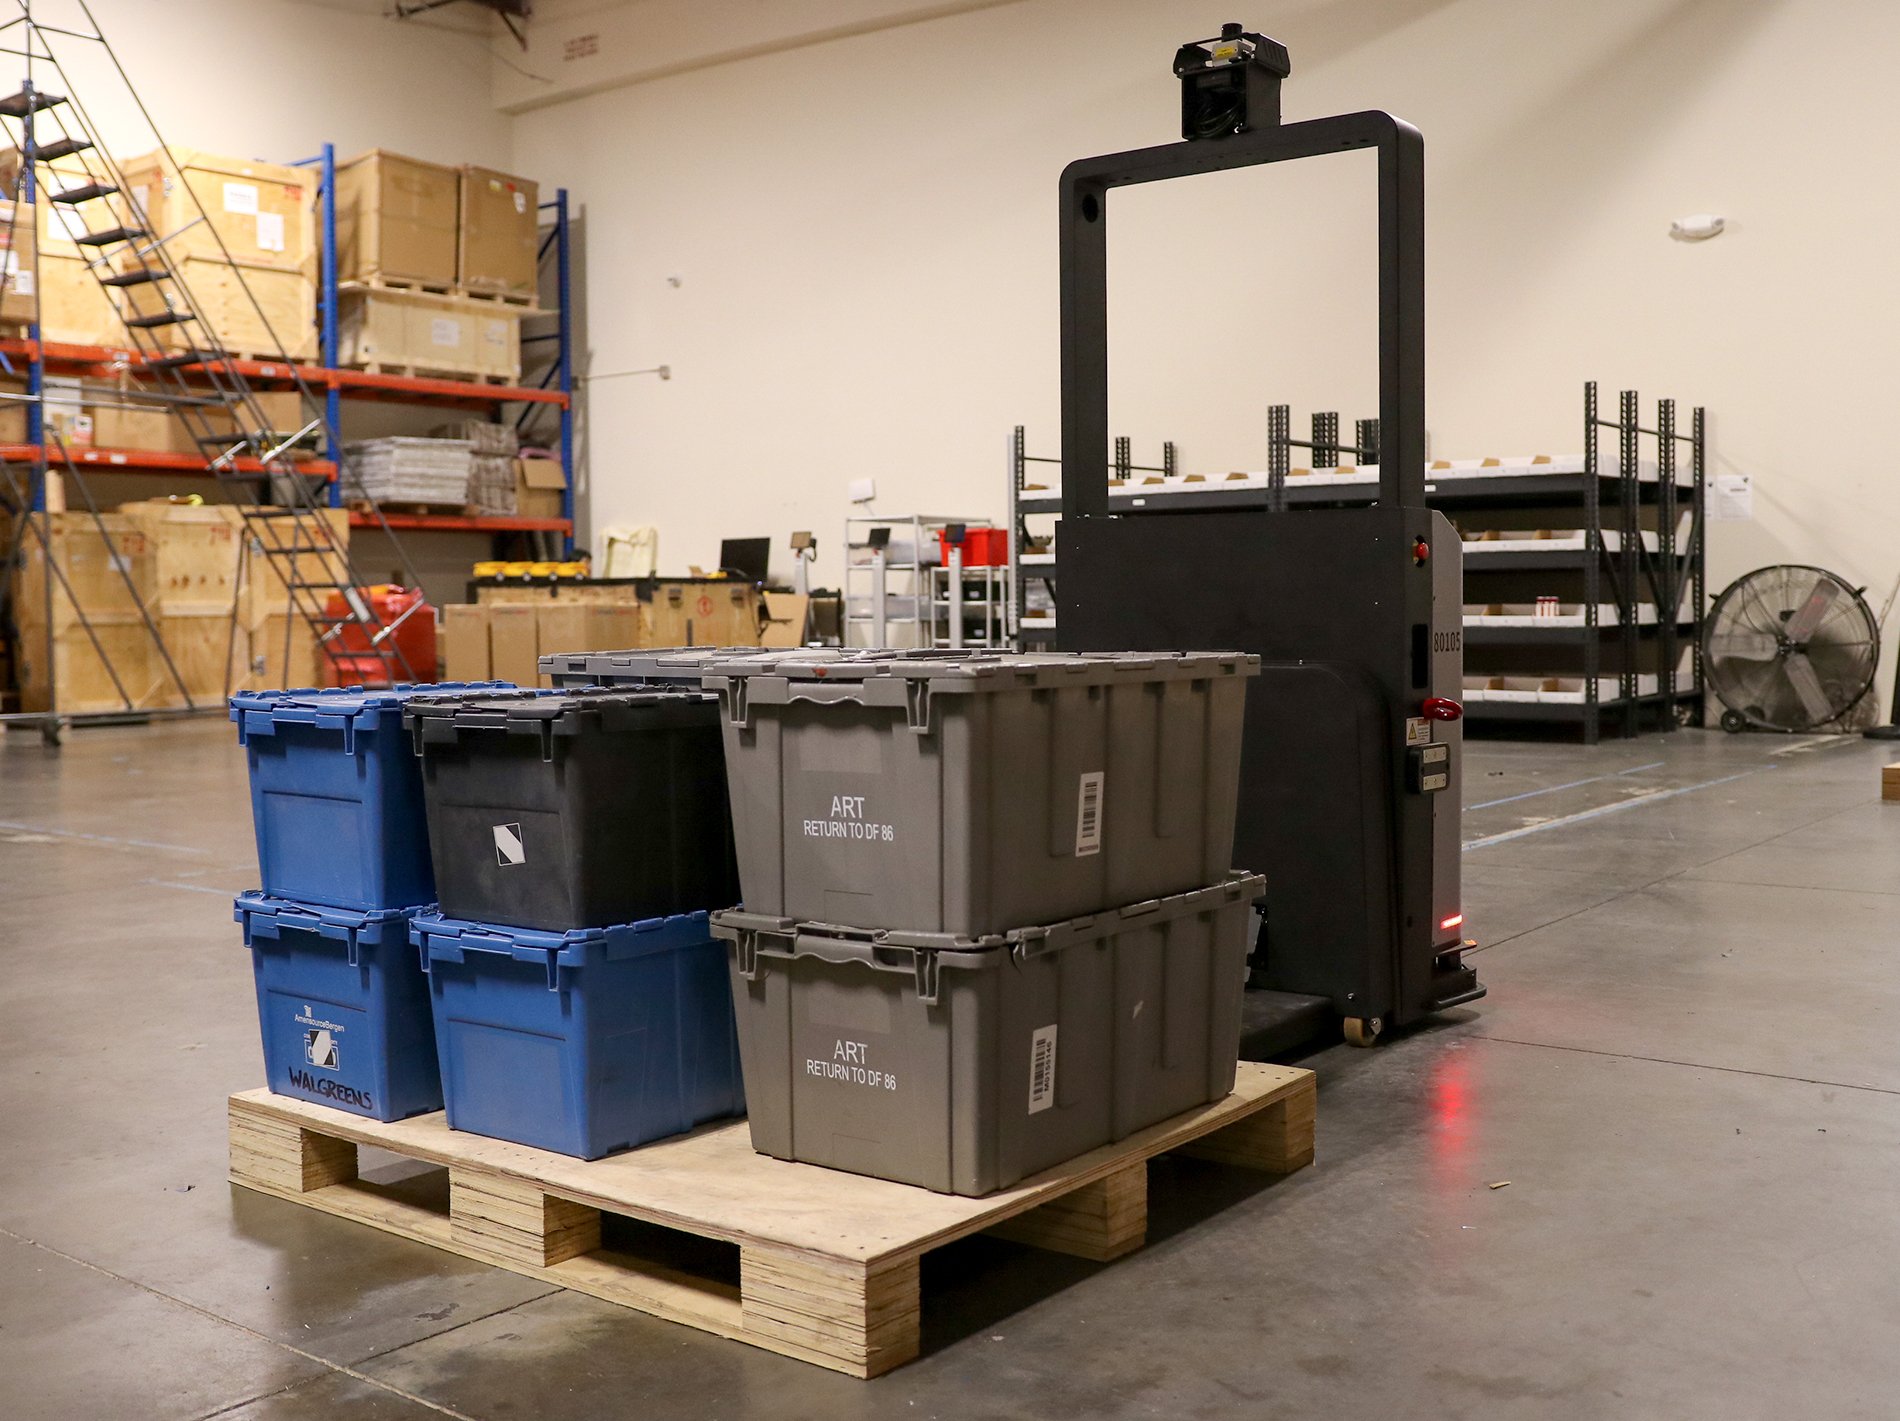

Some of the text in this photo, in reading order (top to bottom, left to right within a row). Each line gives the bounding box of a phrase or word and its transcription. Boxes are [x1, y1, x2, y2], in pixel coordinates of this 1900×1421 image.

[1433, 631, 1461, 653] 80105
[830, 795, 865, 819] ART
[803, 819, 894, 841] RETURN TO DF 86
[833, 1039, 868, 1065] ART
[806, 1058, 897, 1091] RETURN TO DF 86
[288, 1065, 373, 1110] WALGREENS
